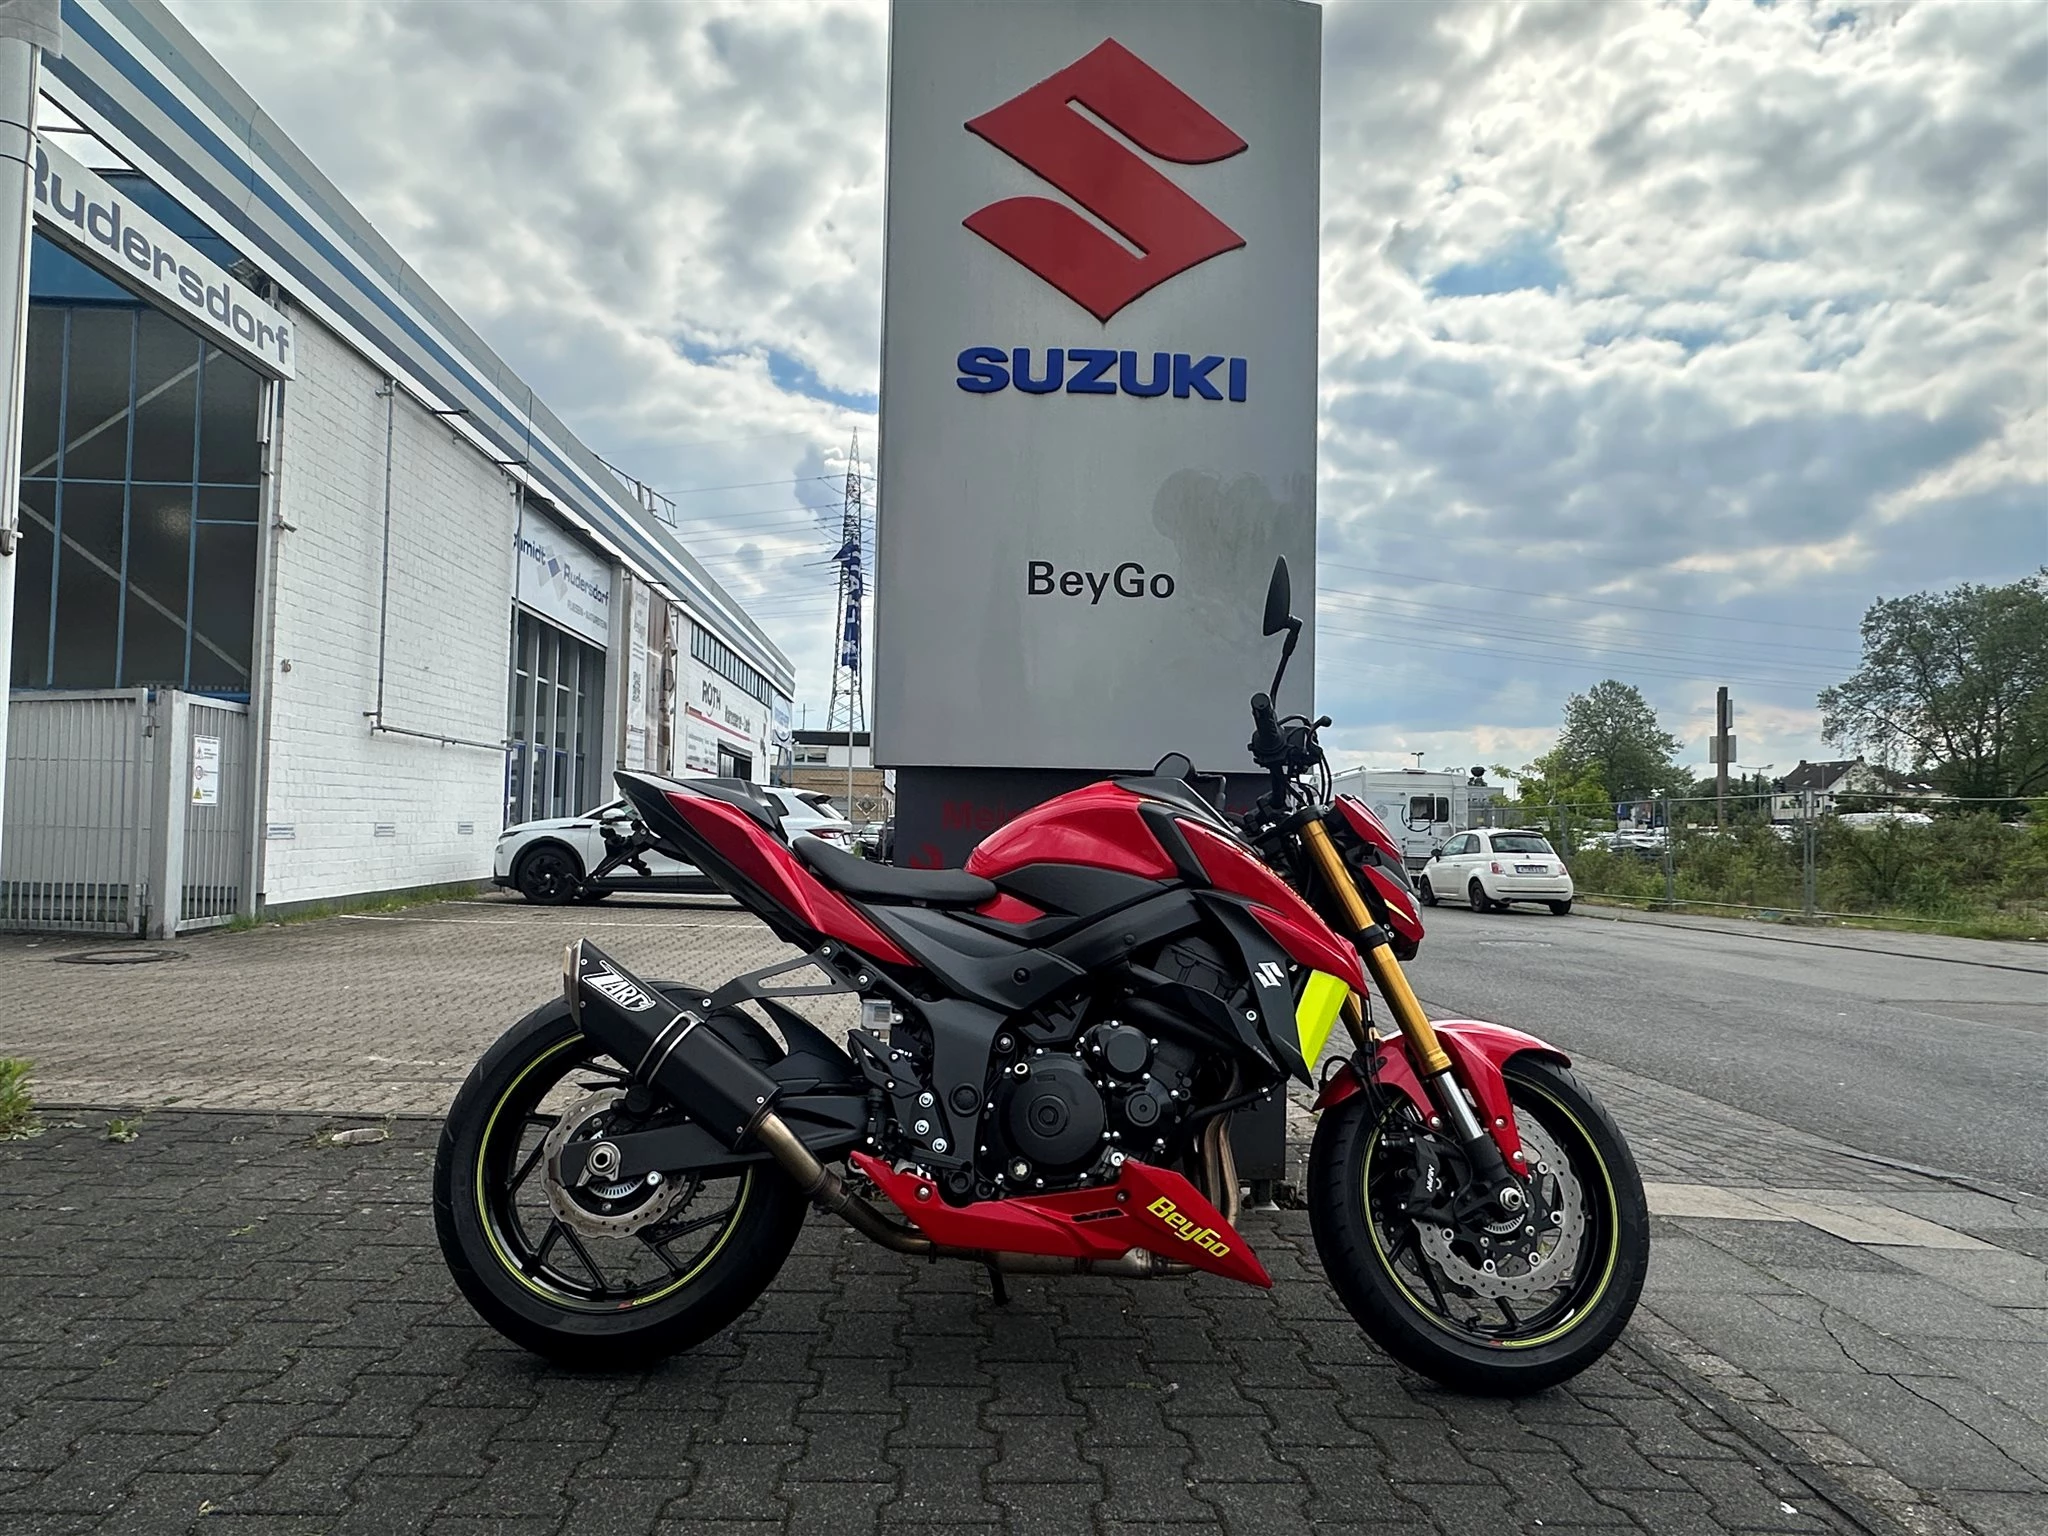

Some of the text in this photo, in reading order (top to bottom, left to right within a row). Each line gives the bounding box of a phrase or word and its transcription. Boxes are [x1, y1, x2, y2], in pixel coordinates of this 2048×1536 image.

[956, 346, 1247, 402] SUZUKI
[563, 563, 609, 606] Rudersdorf
[1028, 561, 1175, 604] BeyGo
[702, 680, 721, 711] ROTH
[1146, 1196, 1231, 1258] BeyGo
